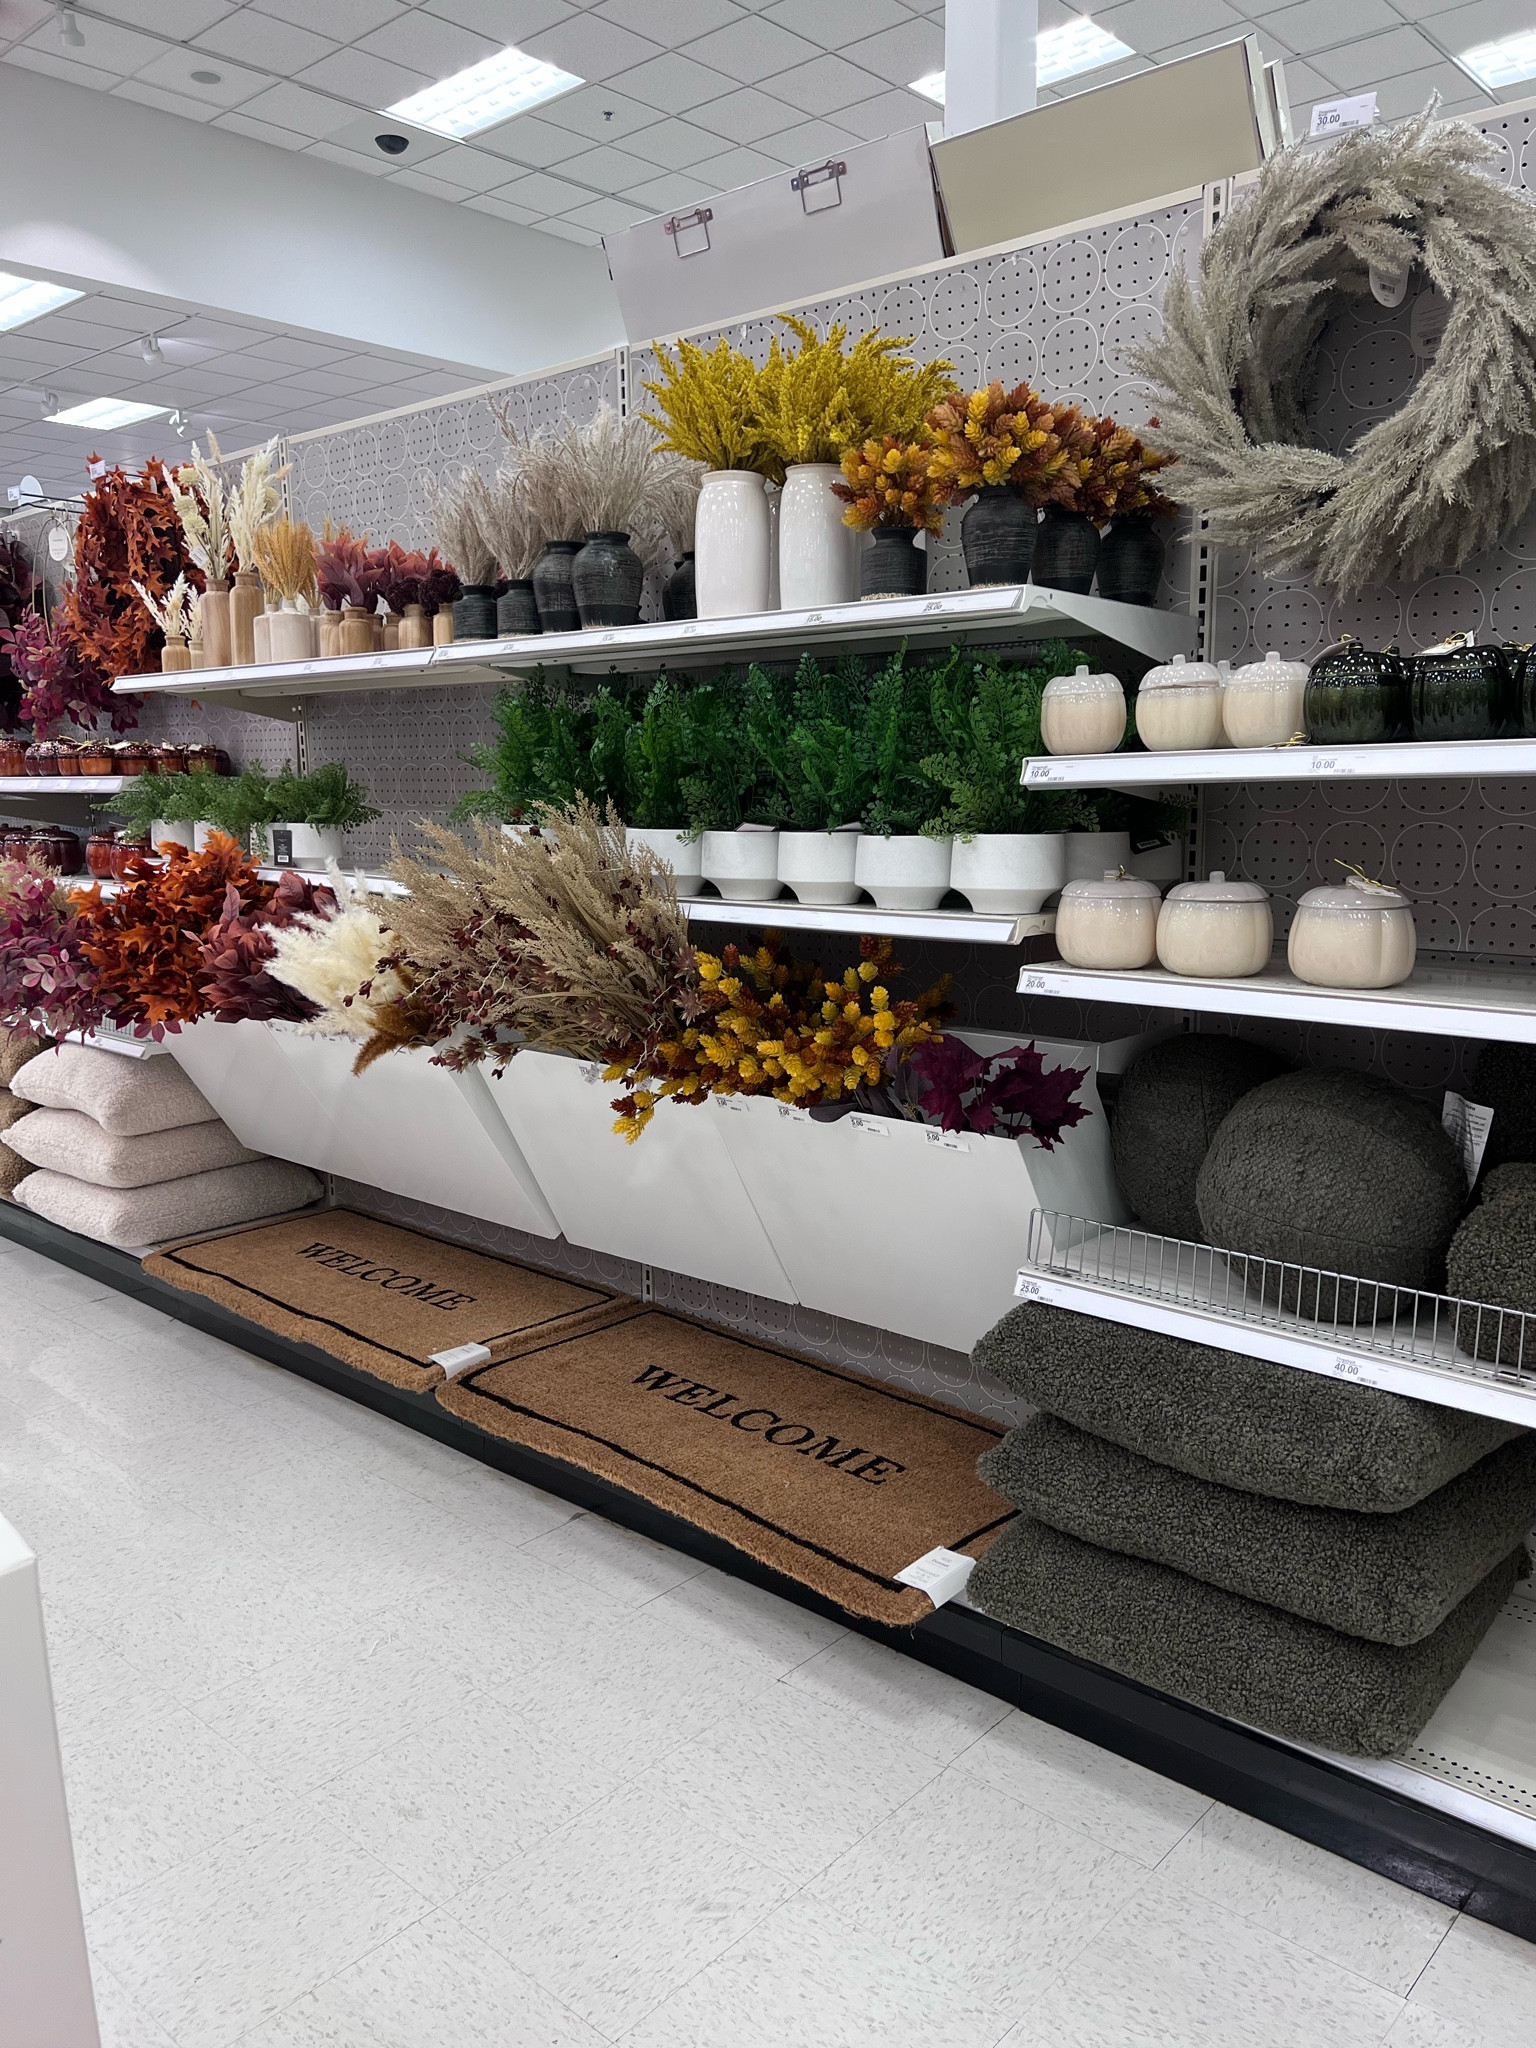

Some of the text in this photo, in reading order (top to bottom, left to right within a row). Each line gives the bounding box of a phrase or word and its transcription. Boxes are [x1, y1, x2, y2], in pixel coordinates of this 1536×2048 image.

[1317, 113, 1341, 126] 30.00
[1311, 760, 1336, 769] 10.00
[1031, 770, 1050, 778] 10.00
[1026, 980, 1046, 989] 20.00
[296, 1242, 479, 1311] WELCOME
[1020, 1284, 1040, 1295] 25.00
[1334, 1362, 1359, 1376] 40.00
[631, 1364, 908, 1486] WELCOME
